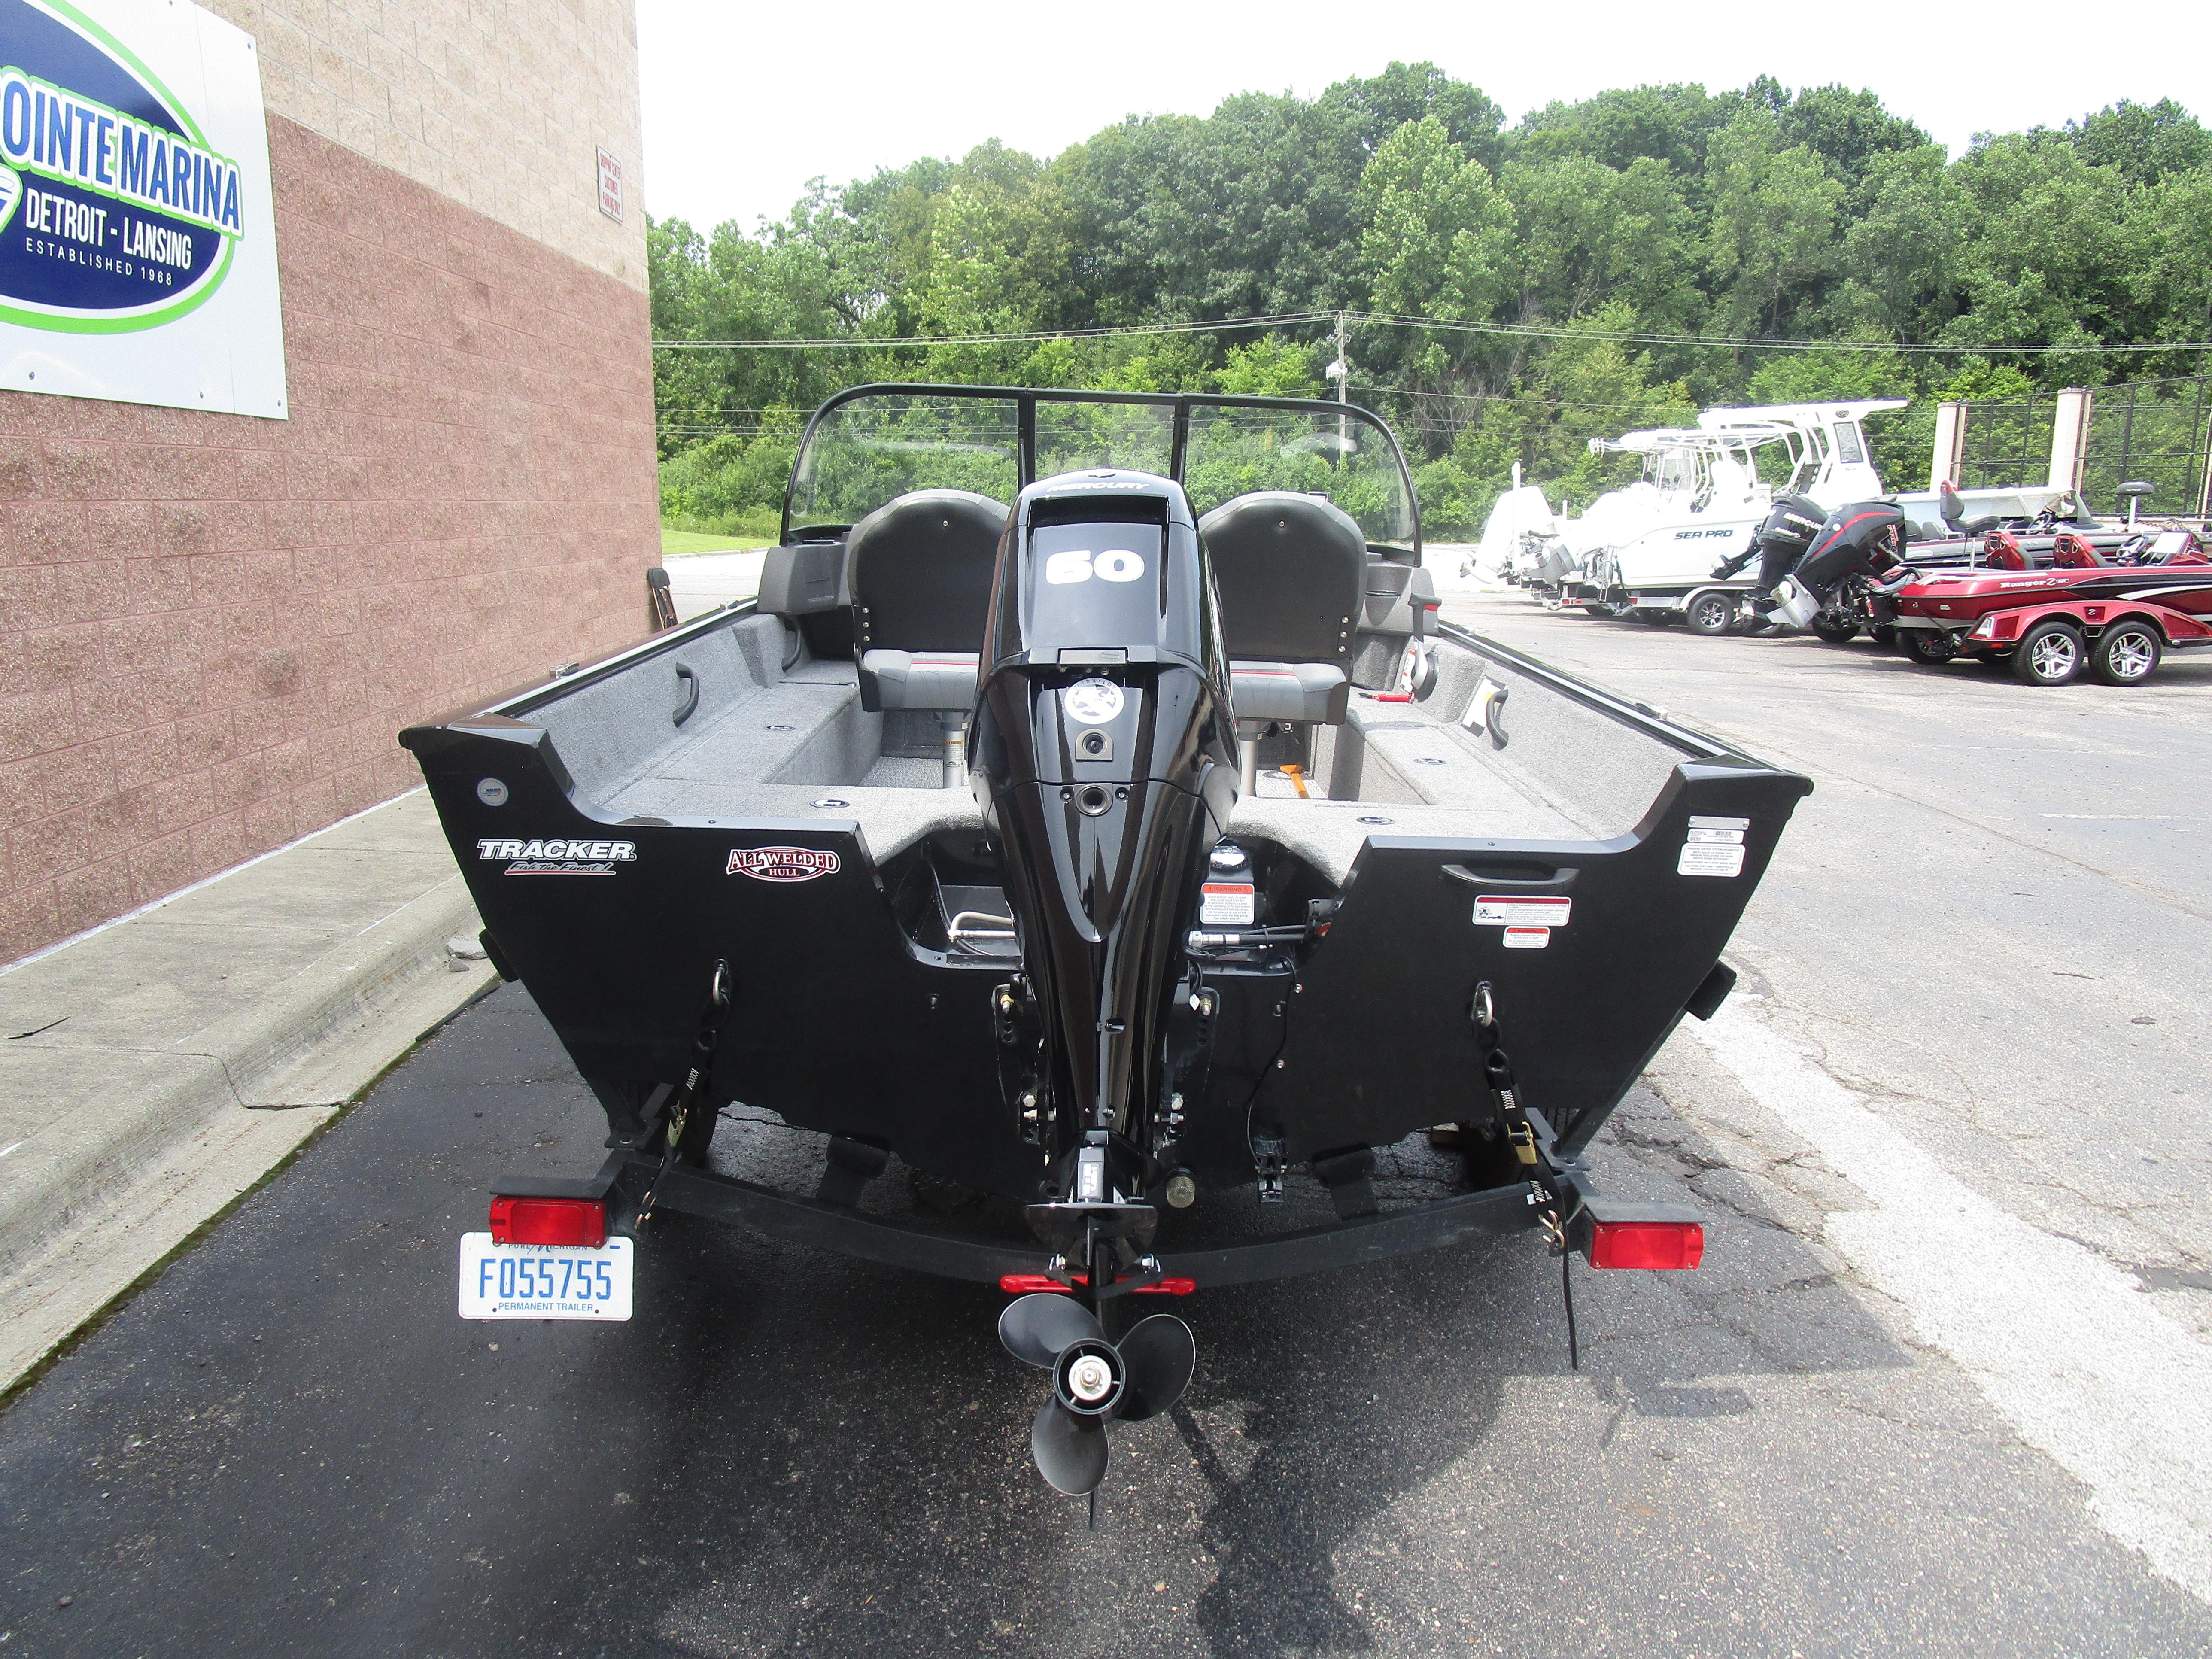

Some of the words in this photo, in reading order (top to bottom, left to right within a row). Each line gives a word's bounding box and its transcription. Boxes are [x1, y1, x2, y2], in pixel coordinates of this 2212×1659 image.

[3, 80, 114, 187] OINTE
[121, 123, 240, 231] MARINA
[26, 188, 107, 247] DETROIT
[123, 216, 192, 269] LANSING
[27, 238, 133, 276] ESTABLISHED
[141, 266, 172, 286] 1968
[1046, 482, 1150, 492] MERCURY
[1783, 512, 1823, 531] MERCUR
[1674, 531, 1702, 540] SEA
[1705, 530, 1733, 538] PRO
[1045, 549, 1145, 584] 60
[2000, 579, 2047, 588] Ranger
[1073, 679, 1097, 690] ULTRA
[477, 839, 632, 860] TRACKER
[511, 863, 537, 871] Fish
[539, 863, 557, 871] the
[729, 851, 764, 870] ALL
[766, 852, 837, 870] WELDED
[480, 1258, 611, 1300] F055755
[556, 1303, 593, 1311] TRAILER
